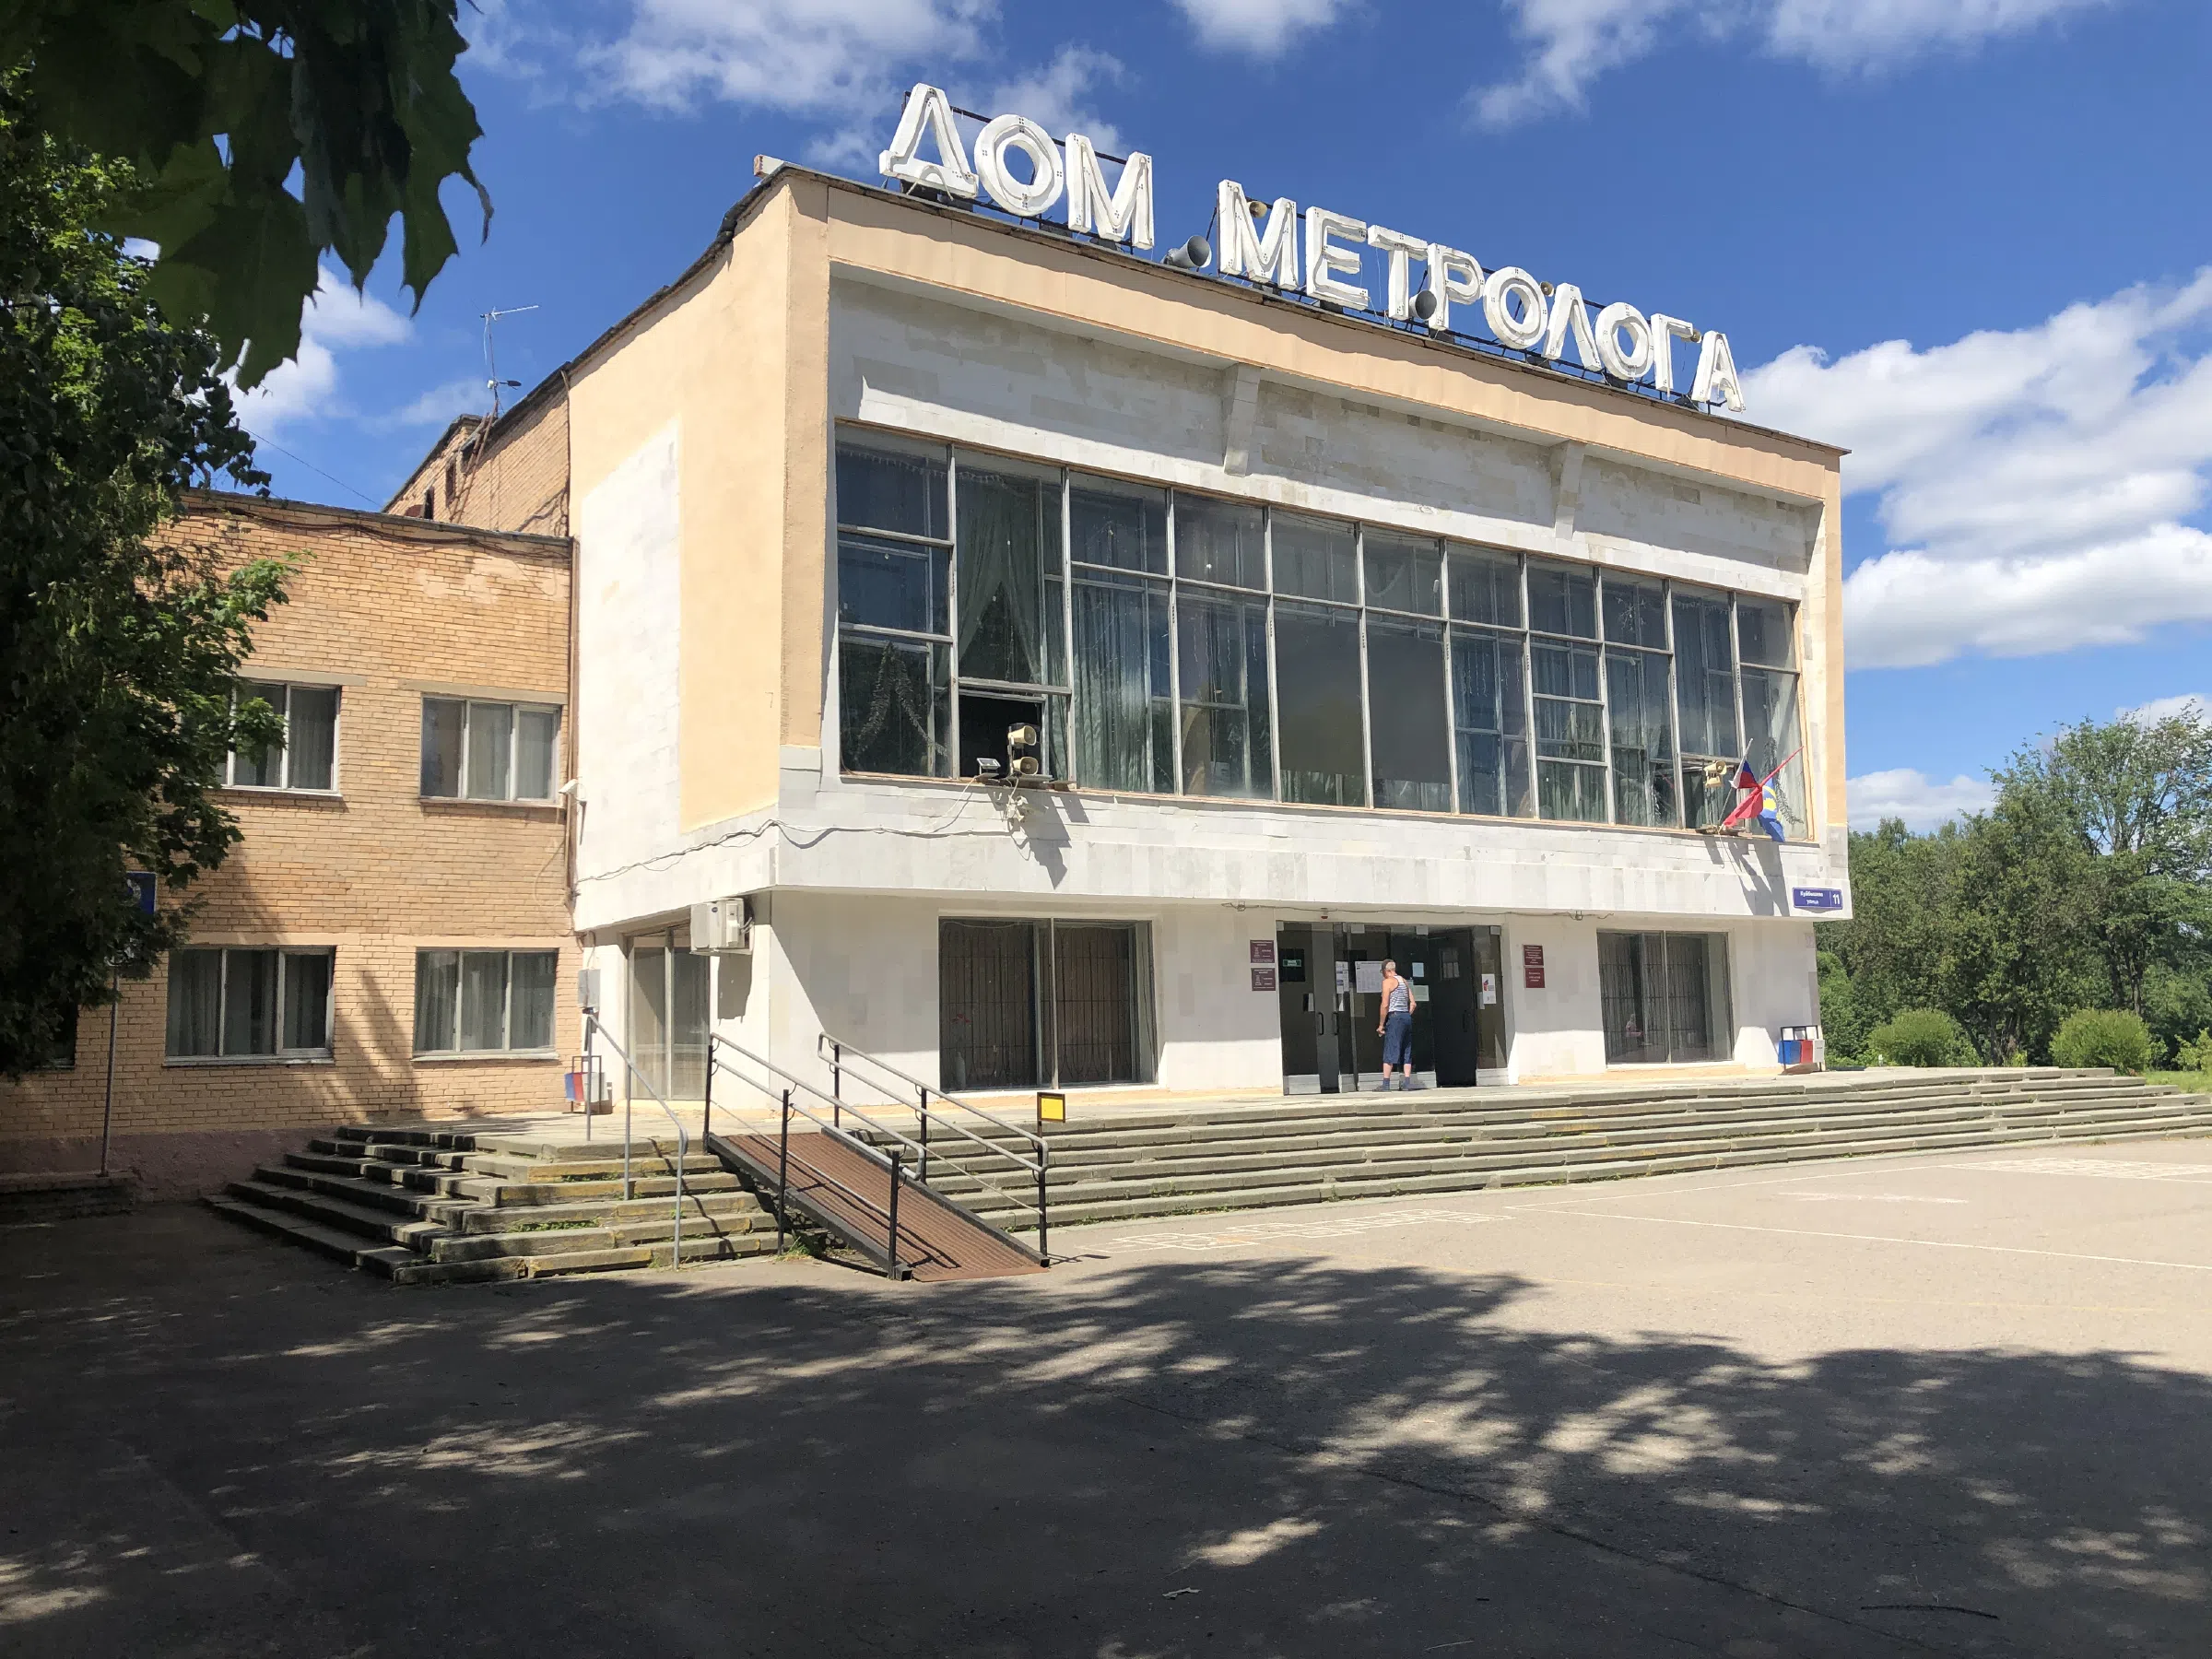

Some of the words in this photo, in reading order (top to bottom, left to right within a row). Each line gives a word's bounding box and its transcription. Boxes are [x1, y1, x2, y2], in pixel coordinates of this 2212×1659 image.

[879, 82, 1154, 250] ДОМ
[1218, 179, 1746, 413] МЕТРОЛОГА
[1832, 894, 1841, 905] 11
